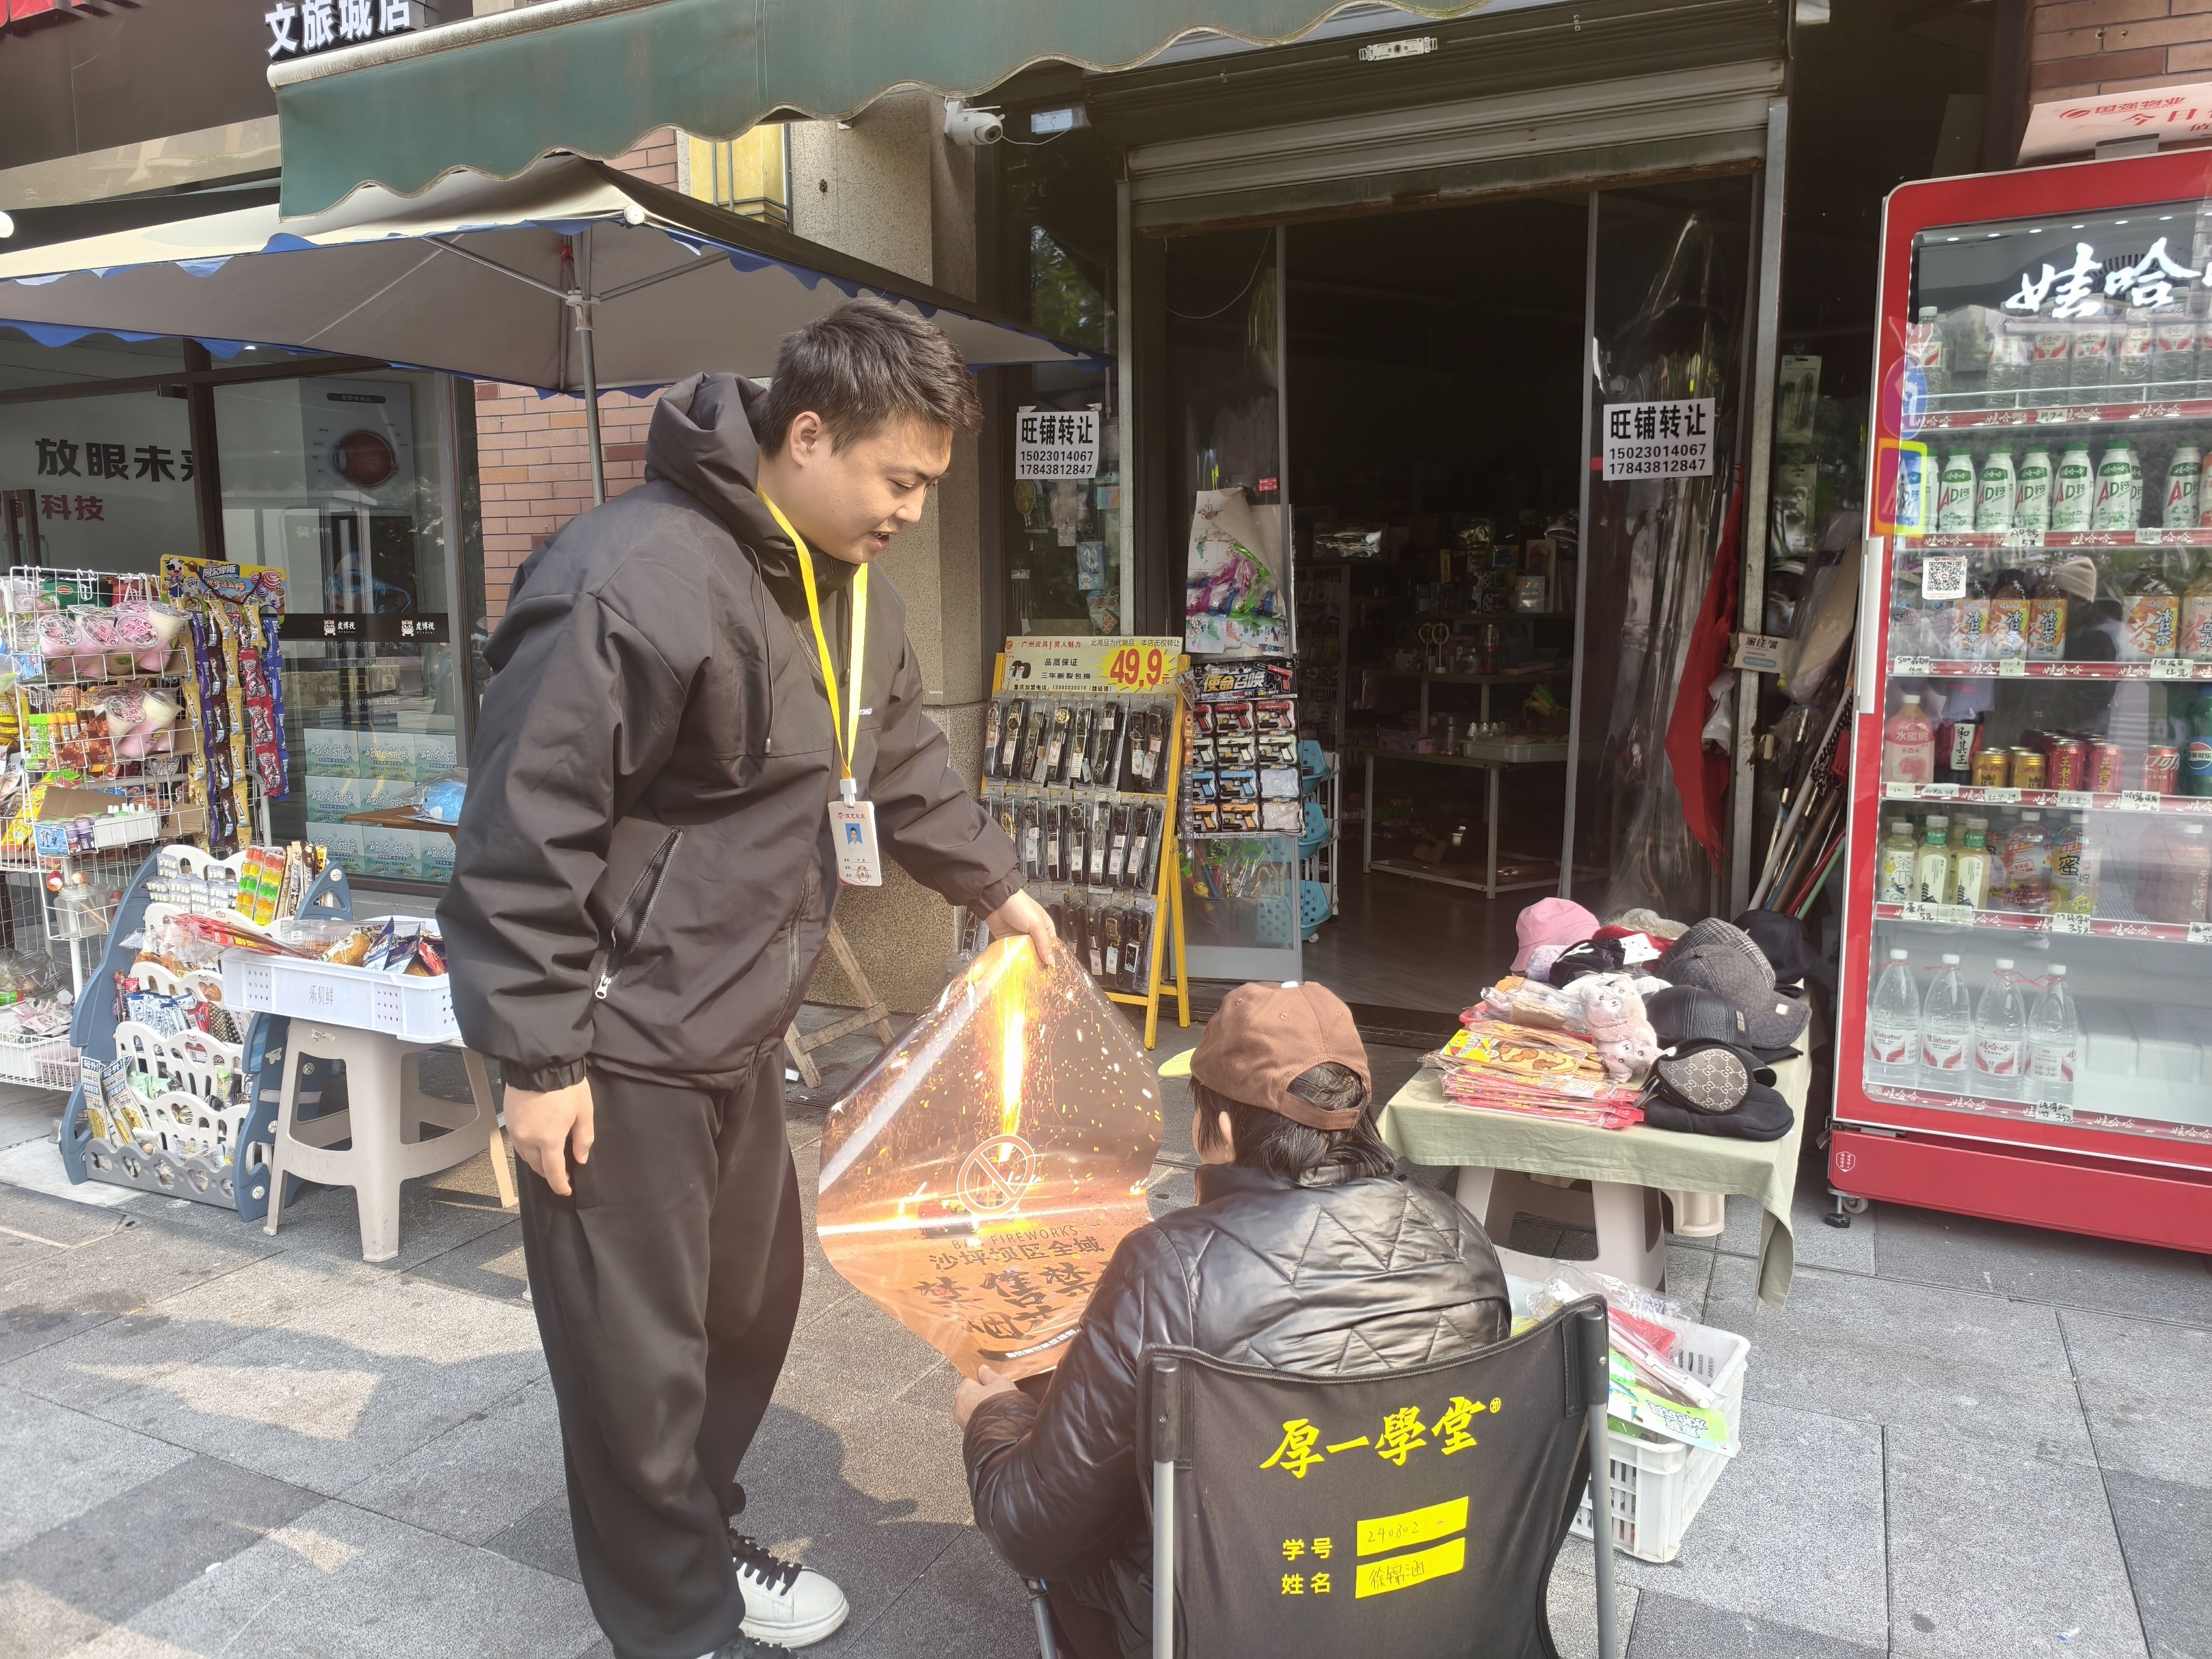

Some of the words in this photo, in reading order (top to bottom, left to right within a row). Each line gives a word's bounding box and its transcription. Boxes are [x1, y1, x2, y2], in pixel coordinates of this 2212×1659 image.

[265, 0, 410, 57] 文旅城店
[2118, 109, 2212, 126] 今日
[2005, 237, 2212, 319] 娃哈
[2138, 404, 2181, 417] 娃哈哈
[1610, 404, 1706, 440] 旺铺转让
[1021, 415, 1093, 446] 旺铺转让
[1020, 451, 1094, 462] 15023014067
[1609, 443, 1706, 460] 15023014067
[1020, 464, 1093, 475] 17843812847
[1609, 459, 1705, 475] 17843812847
[1924, 535, 1963, 546] 娃哈哈
[2070, 533, 2112, 544] 娃哈哈
[2160, 531, 2190, 543] 哈哈
[203, 564, 237, 578] 阿尔卑斯
[338, 621, 356, 630] 虎博视
[416, 622, 435, 631] 虎博视
[1967, 611, 1982, 643] 冰红茶
[2006, 611, 2022, 643] 冰红茶
[2040, 611, 2057, 643] 冰红茶
[2154, 609, 2173, 646] 冰红茶
[1109, 648, 1162, 687] 49.9
[2042, 664, 2083, 675] 娃哈哈
[1162, 673, 1170, 684] 元
[1203, 671, 1266, 693] 使命召唤
[1896, 731, 1928, 741] 水蜜桃
[1955, 726, 1970, 765] 和其正
[1961, 790, 1985, 801] 娃哈
[2033, 793, 2057, 805] 娃哈
[1972, 913, 2001, 925] 哈哈
[2109, 923, 2151, 936] 娃哈哈
[309, 985, 334, 1006] 乐贝鲜
[1927, 1034, 1960, 1044] Wahaha
[1978, 1041, 2010, 1052] 娃哈哈
[1882, 1089, 1919, 1101] 娃哈哈
[1950, 1097, 1987, 1109] 娃哈哈
[2094, 1115, 2134, 1128] 娃哈哈
[2170, 1125, 2212, 1138] 娃哈哈
[992, 1225, 1078, 1245] FIREWORKS
[928, 1235, 1105, 1270] 沙坪坝区全域
[912, 1261, 1114, 1310] 禁售禁
[1259, 1396, 1486, 1479] 厚一學堂
[1282, 1536, 1333, 1561] 学号
[1281, 1572, 1331, 1595] 姓名
